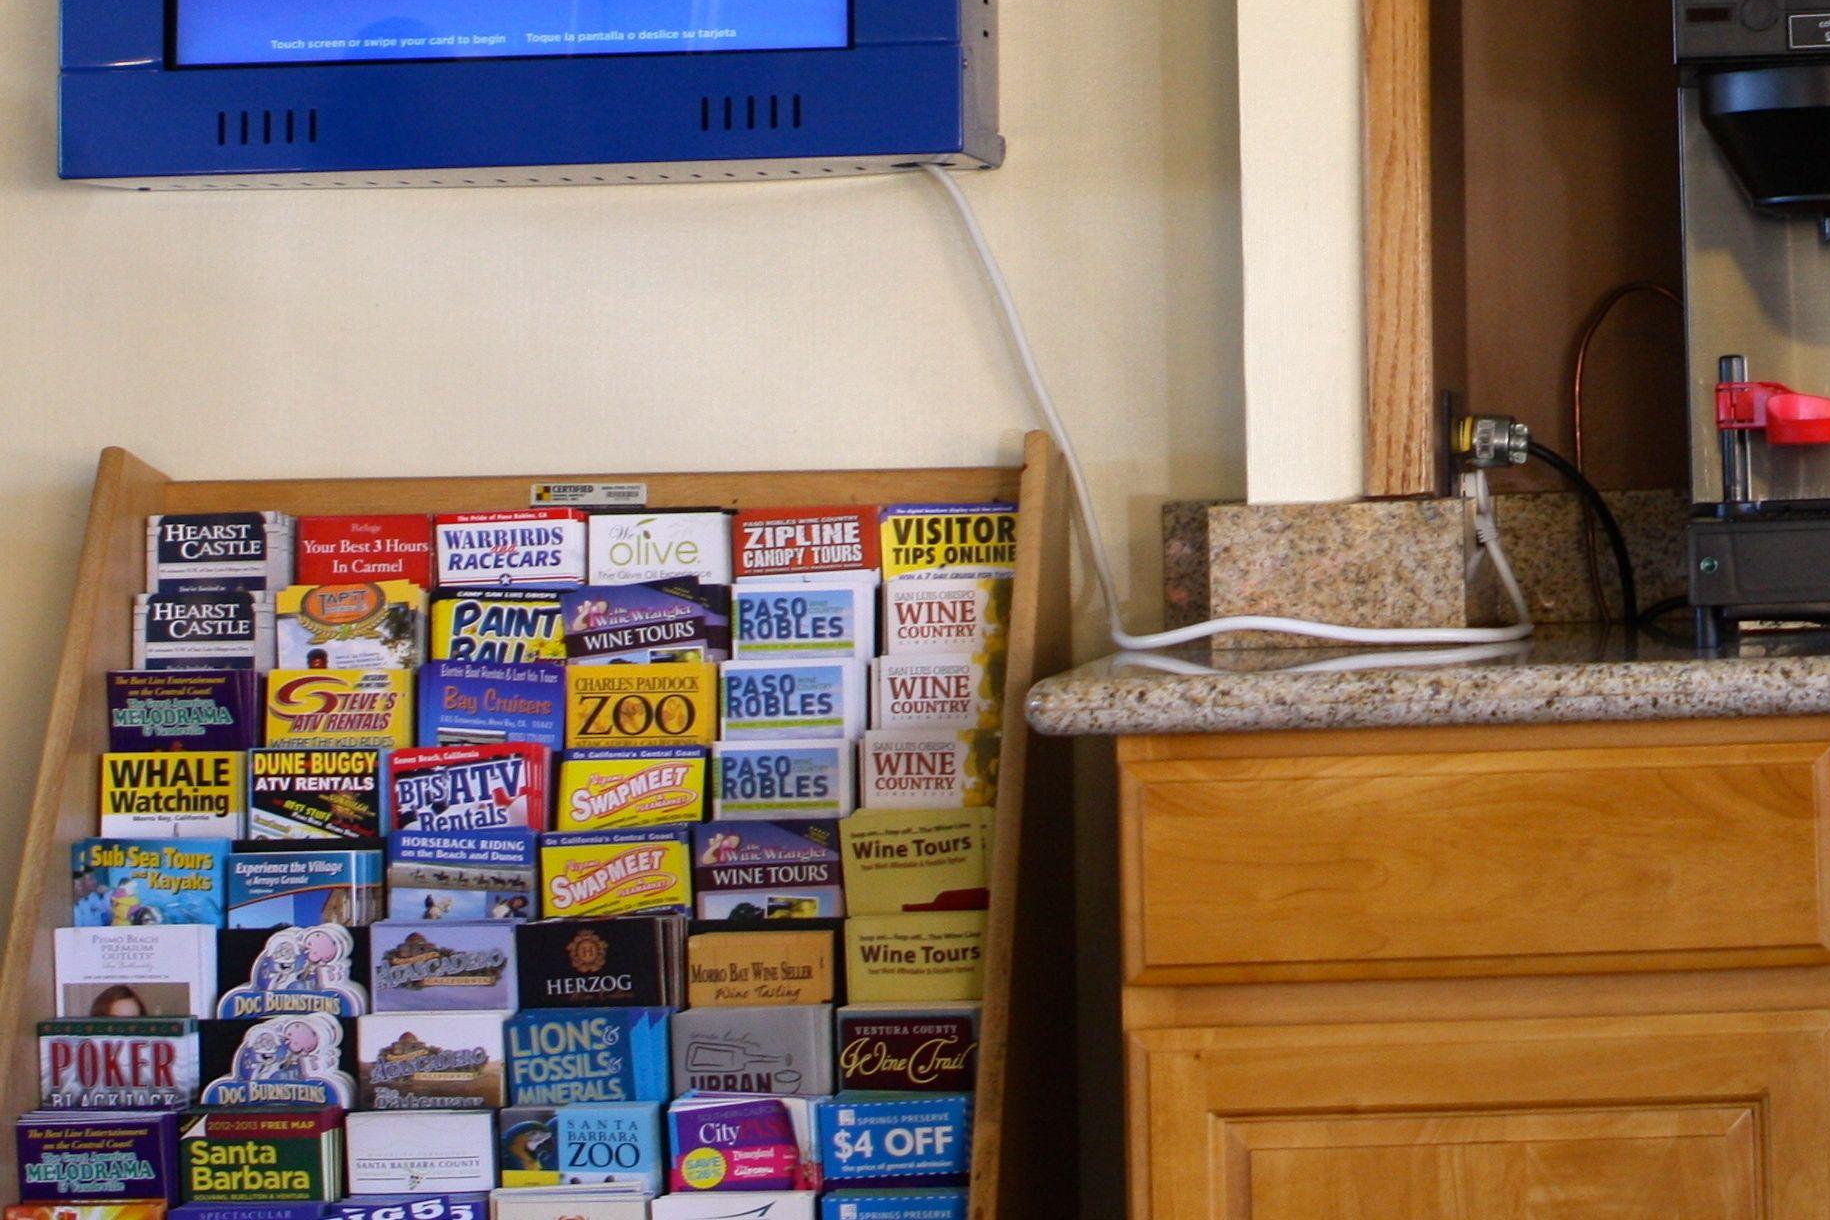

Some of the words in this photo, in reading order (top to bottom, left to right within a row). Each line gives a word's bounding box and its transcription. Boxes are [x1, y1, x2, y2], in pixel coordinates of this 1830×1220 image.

[271, 39, 304, 49] Touch
[308, 40, 345, 48] screen
[364, 37, 397, 47] swipe
[401, 38, 425, 47] your
[429, 36, 454, 45] card
[458, 36, 470, 44] to
[473, 35, 506, 45] begin
[552, 484, 593, 493] CERTIFIED
[165, 524, 251, 542] HEARST
[445, 527, 563, 549] WARBIRDS
[743, 523, 860, 550] ZIPLINE
[894, 516, 1016, 546] VISITOR
[181, 539, 261, 559] CASTLE
[304, 539, 335, 553] Your
[340, 539, 370, 552] Best
[373, 540, 383, 552] 3
[386, 539, 429, 552] Hours
[743, 547, 805, 569] CANOPY
[811, 544, 863, 564] TOURS
[893, 547, 936, 566] TIPS
[944, 544, 1016, 564] ONLINE
[333, 560, 348, 574] In
[352, 559, 403, 573] Carmel
[448, 550, 562, 571] RACECARS
[154, 603, 239, 621] HEARST
[453, 600, 561, 638] PAINT
[739, 596, 808, 621] PASO
[895, 600, 976, 625] WINE
[169, 619, 250, 638] CASTLE
[585, 631, 634, 651] WINE
[638, 621, 695, 646] TOURS
[739, 616, 843, 640] ROBLES
[898, 625, 976, 639] COUNTRY
[575, 677, 633, 691] CHARLES
[636, 676, 699, 690] PADDOCK
[727, 674, 796, 697] PASO
[888, 675, 971, 700] WINE
[444, 686, 477, 712] Bay
[484, 689, 552, 715] Cruisers
[727, 693, 832, 718] ROBLES
[891, 700, 970, 714] COUNTRY
[111, 708, 234, 728] MELODRAMA
[291, 714, 324, 732] ATV
[327, 712, 392, 731] RENTALS
[578, 694, 696, 736] ZOO
[109, 758, 230, 788] WHALE
[254, 753, 304, 775] DUNE
[310, 752, 377, 776] BUGGY
[721, 755, 791, 779] PASO
[872, 752, 956, 776] WINE
[255, 777, 290, 792] ATV
[295, 776, 375, 791] RENTALS
[449, 759, 525, 806] ATV
[721, 776, 828, 801] ROBLES
[875, 776, 956, 790] COUNTRY
[110, 788, 229, 817] Watching
[419, 802, 508, 831] Rentals
[402, 837, 475, 849] HORSEBACK
[480, 839, 525, 851] RIDING
[852, 839, 908, 860] Wine
[912, 834, 972, 857] Tours
[91, 845, 125, 868] Sub
[128, 847, 160, 867] Sea
[164, 848, 213, 869] Tours
[149, 873, 212, 895] Kayaks
[714, 867, 764, 885] WINE
[770, 864, 827, 883] TOURS
[861, 945, 916, 964] Wine
[920, 943, 981, 962] Tours
[547, 974, 632, 996] HERZOG
[235, 994, 261, 1015] DOC
[265, 992, 341, 1016] BURNSTEIN'S
[510, 1017, 607, 1058] LIONS
[602, 1026, 619, 1047] &
[51, 1040, 175, 1089] POKER
[513, 1050, 612, 1080] FOSSILS
[207, 1120, 256, 1131] 2012-2013
[260, 1121, 288, 1130] FREE
[292, 1120, 314, 1130] MAP
[567, 1119, 638, 1130] SANTA
[567, 1131, 638, 1142] BARBARA
[699, 1121, 740, 1146] City
[191, 1141, 277, 1166] Santa
[567, 1141, 640, 1168] ZOO
[834, 1128, 873, 1163] $4
[885, 1126, 953, 1156] OFF
[25, 1160, 155, 1183] MELODRAMA
[192, 1168, 310, 1192] Barbara
